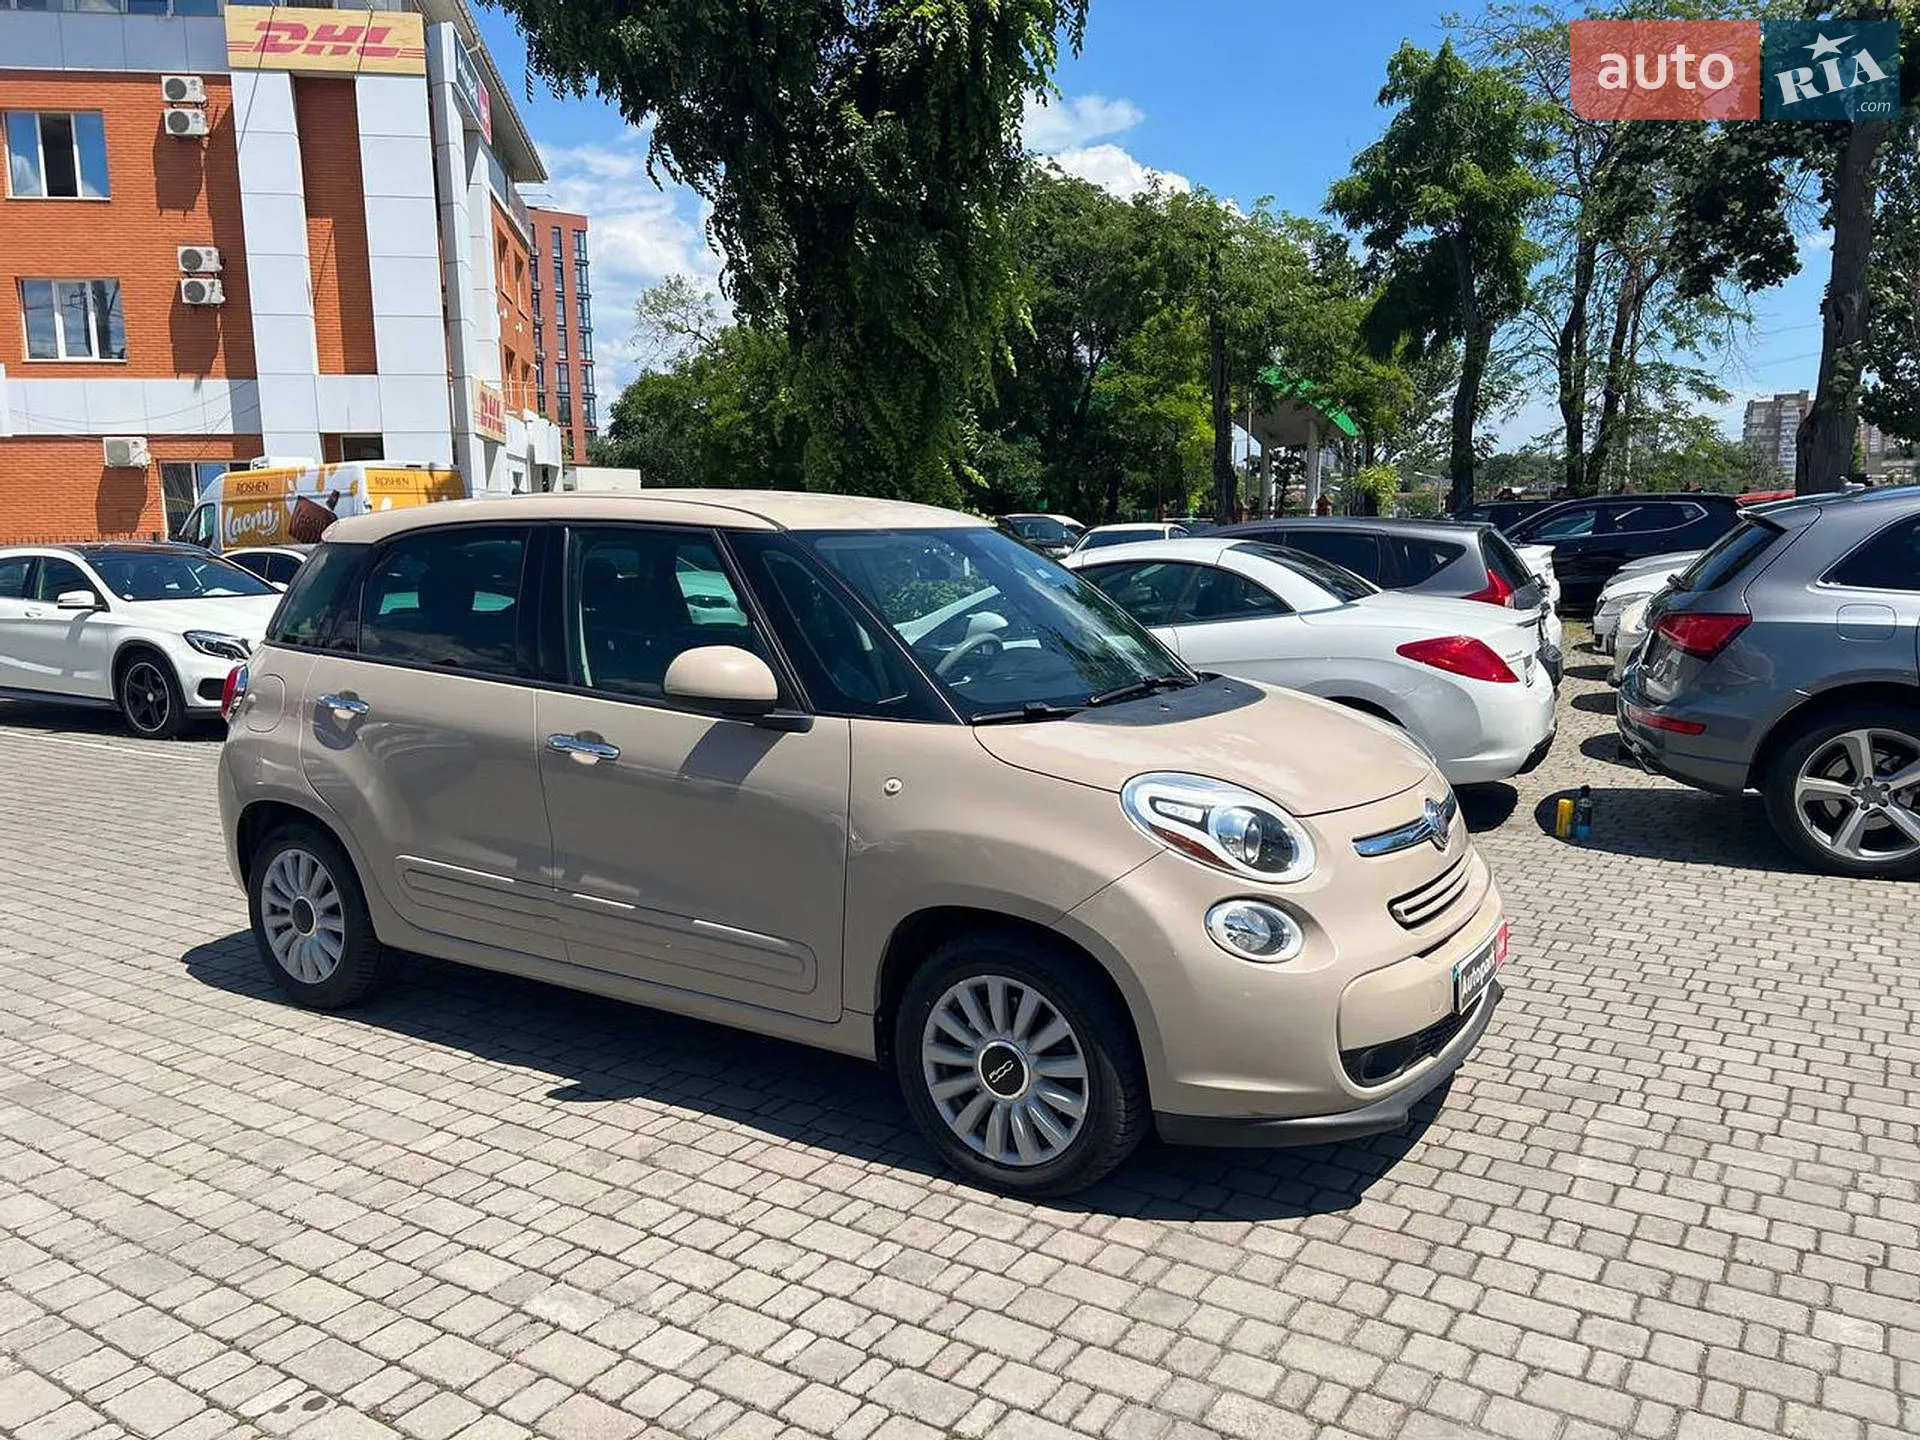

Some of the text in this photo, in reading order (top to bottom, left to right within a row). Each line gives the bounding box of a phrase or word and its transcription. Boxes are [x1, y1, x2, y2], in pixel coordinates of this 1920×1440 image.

[252, 21, 399, 57] DHL
[480, 391, 505, 433] DHL
[235, 480, 270, 495] ROSHEN
[374, 475, 409, 487] ROSHEN
